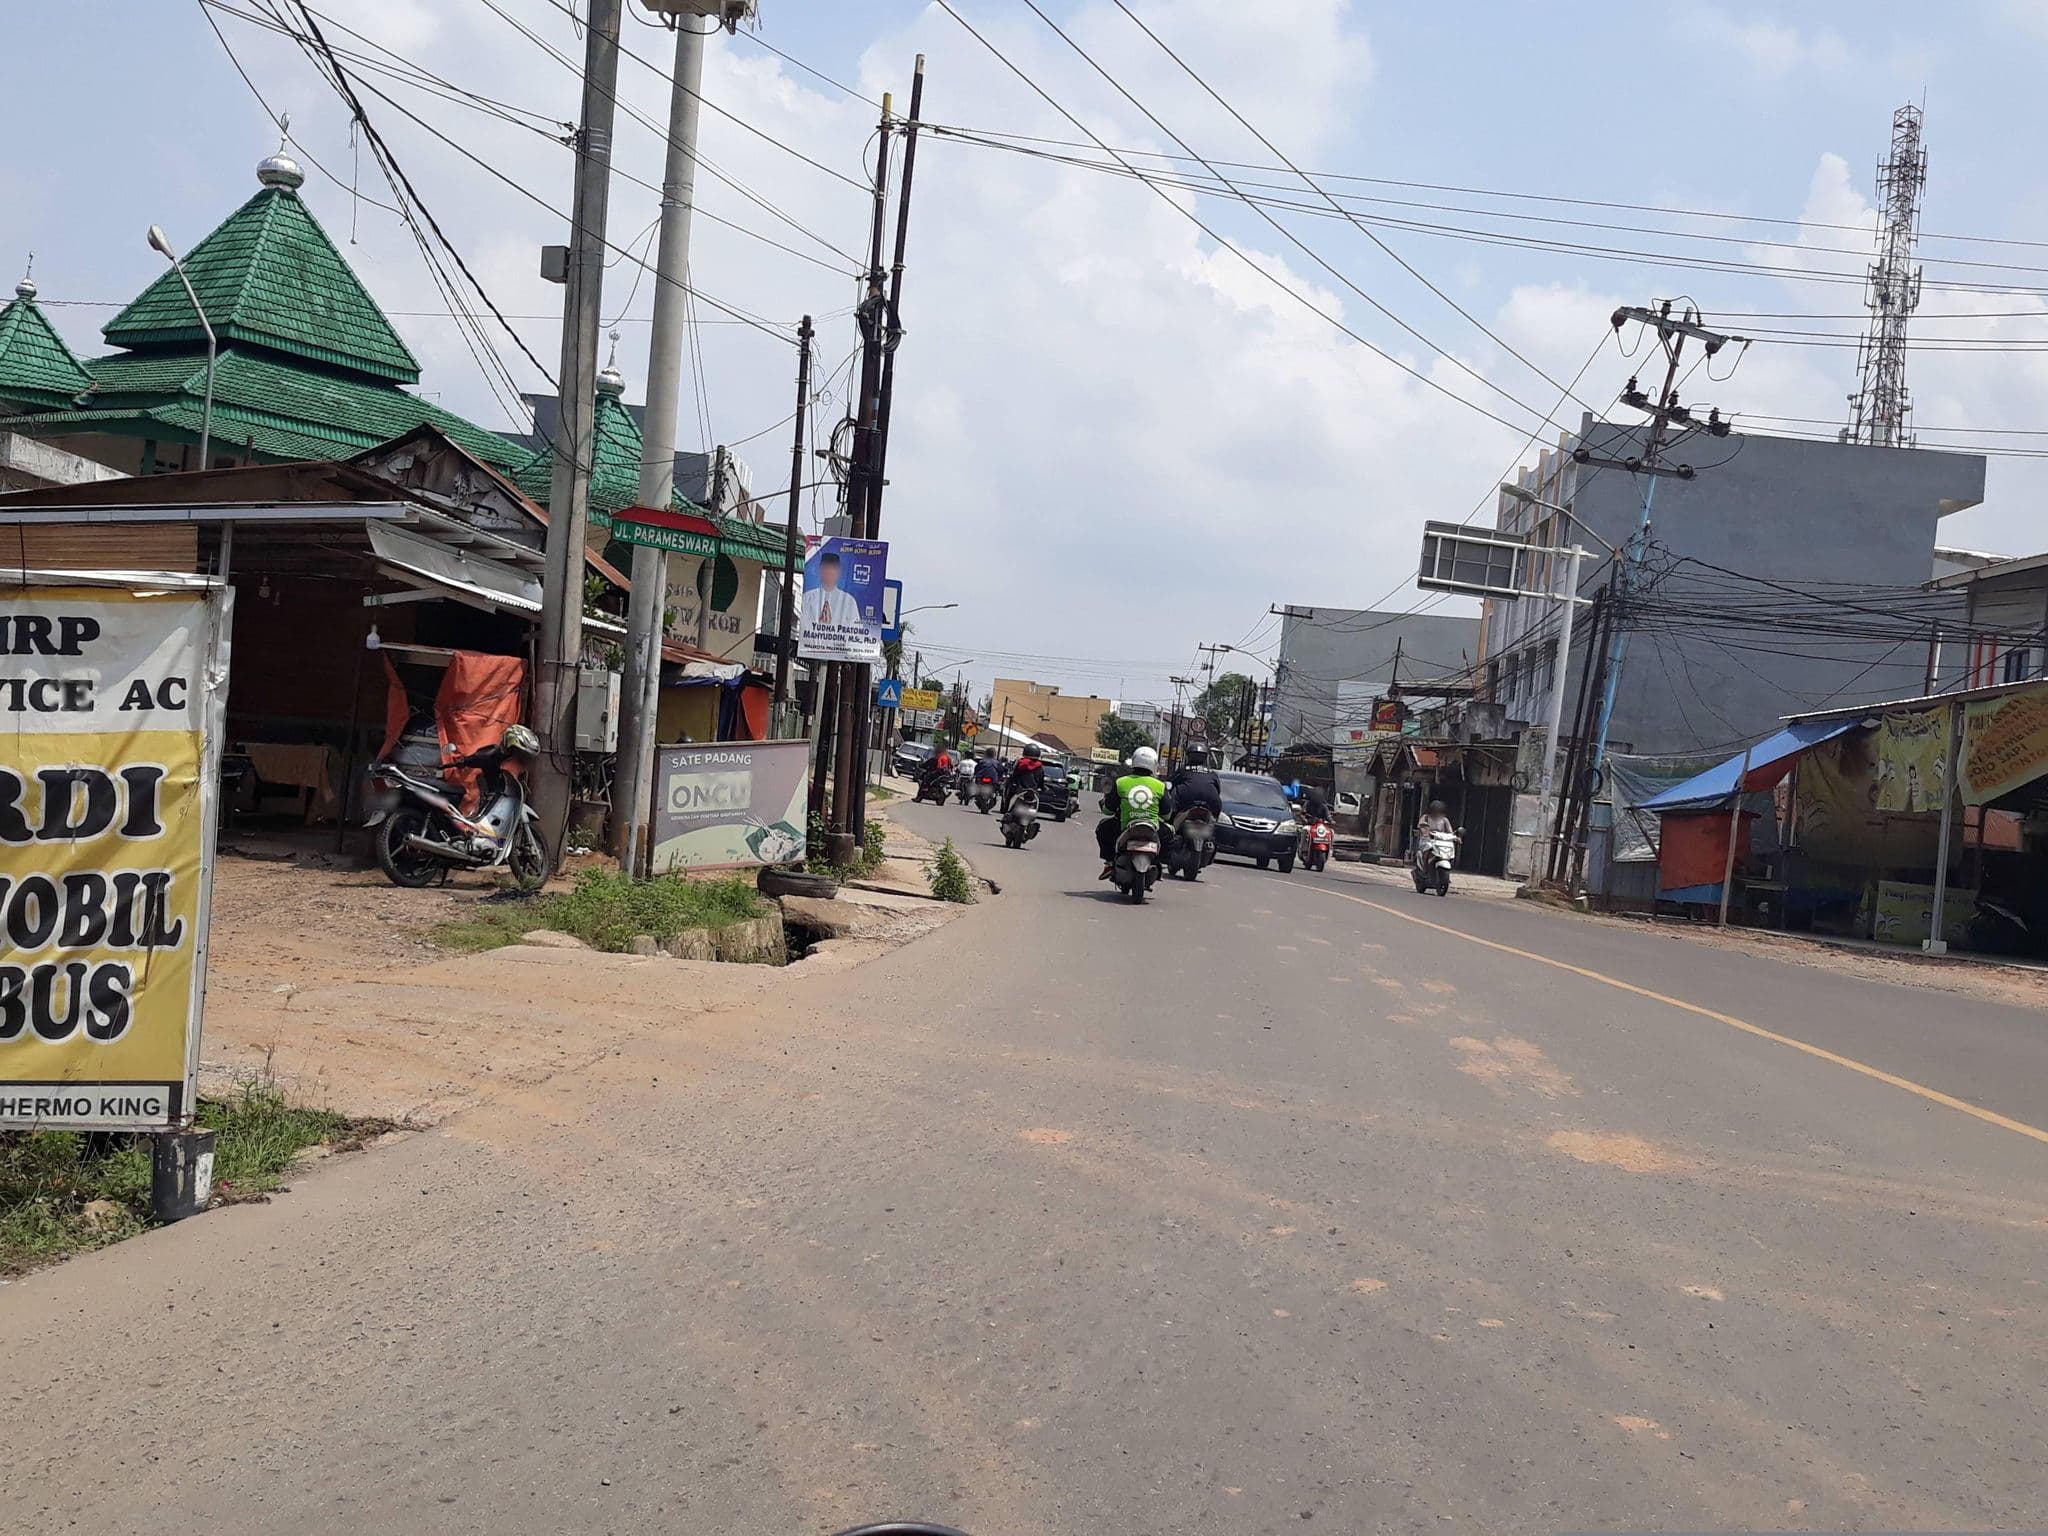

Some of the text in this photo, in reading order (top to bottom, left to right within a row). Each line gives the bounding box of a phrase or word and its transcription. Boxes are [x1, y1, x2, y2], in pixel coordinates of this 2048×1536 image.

[614, 523, 716, 554] JL. PARAMESWARA
[812, 622, 869, 635] YUDHA PRATOMO
[118, 677, 187, 711] AC
[671, 752, 752, 768] SATE PADANG
[0, 872, 182, 949] OBIL
[99, 1097, 161, 1117] KING
